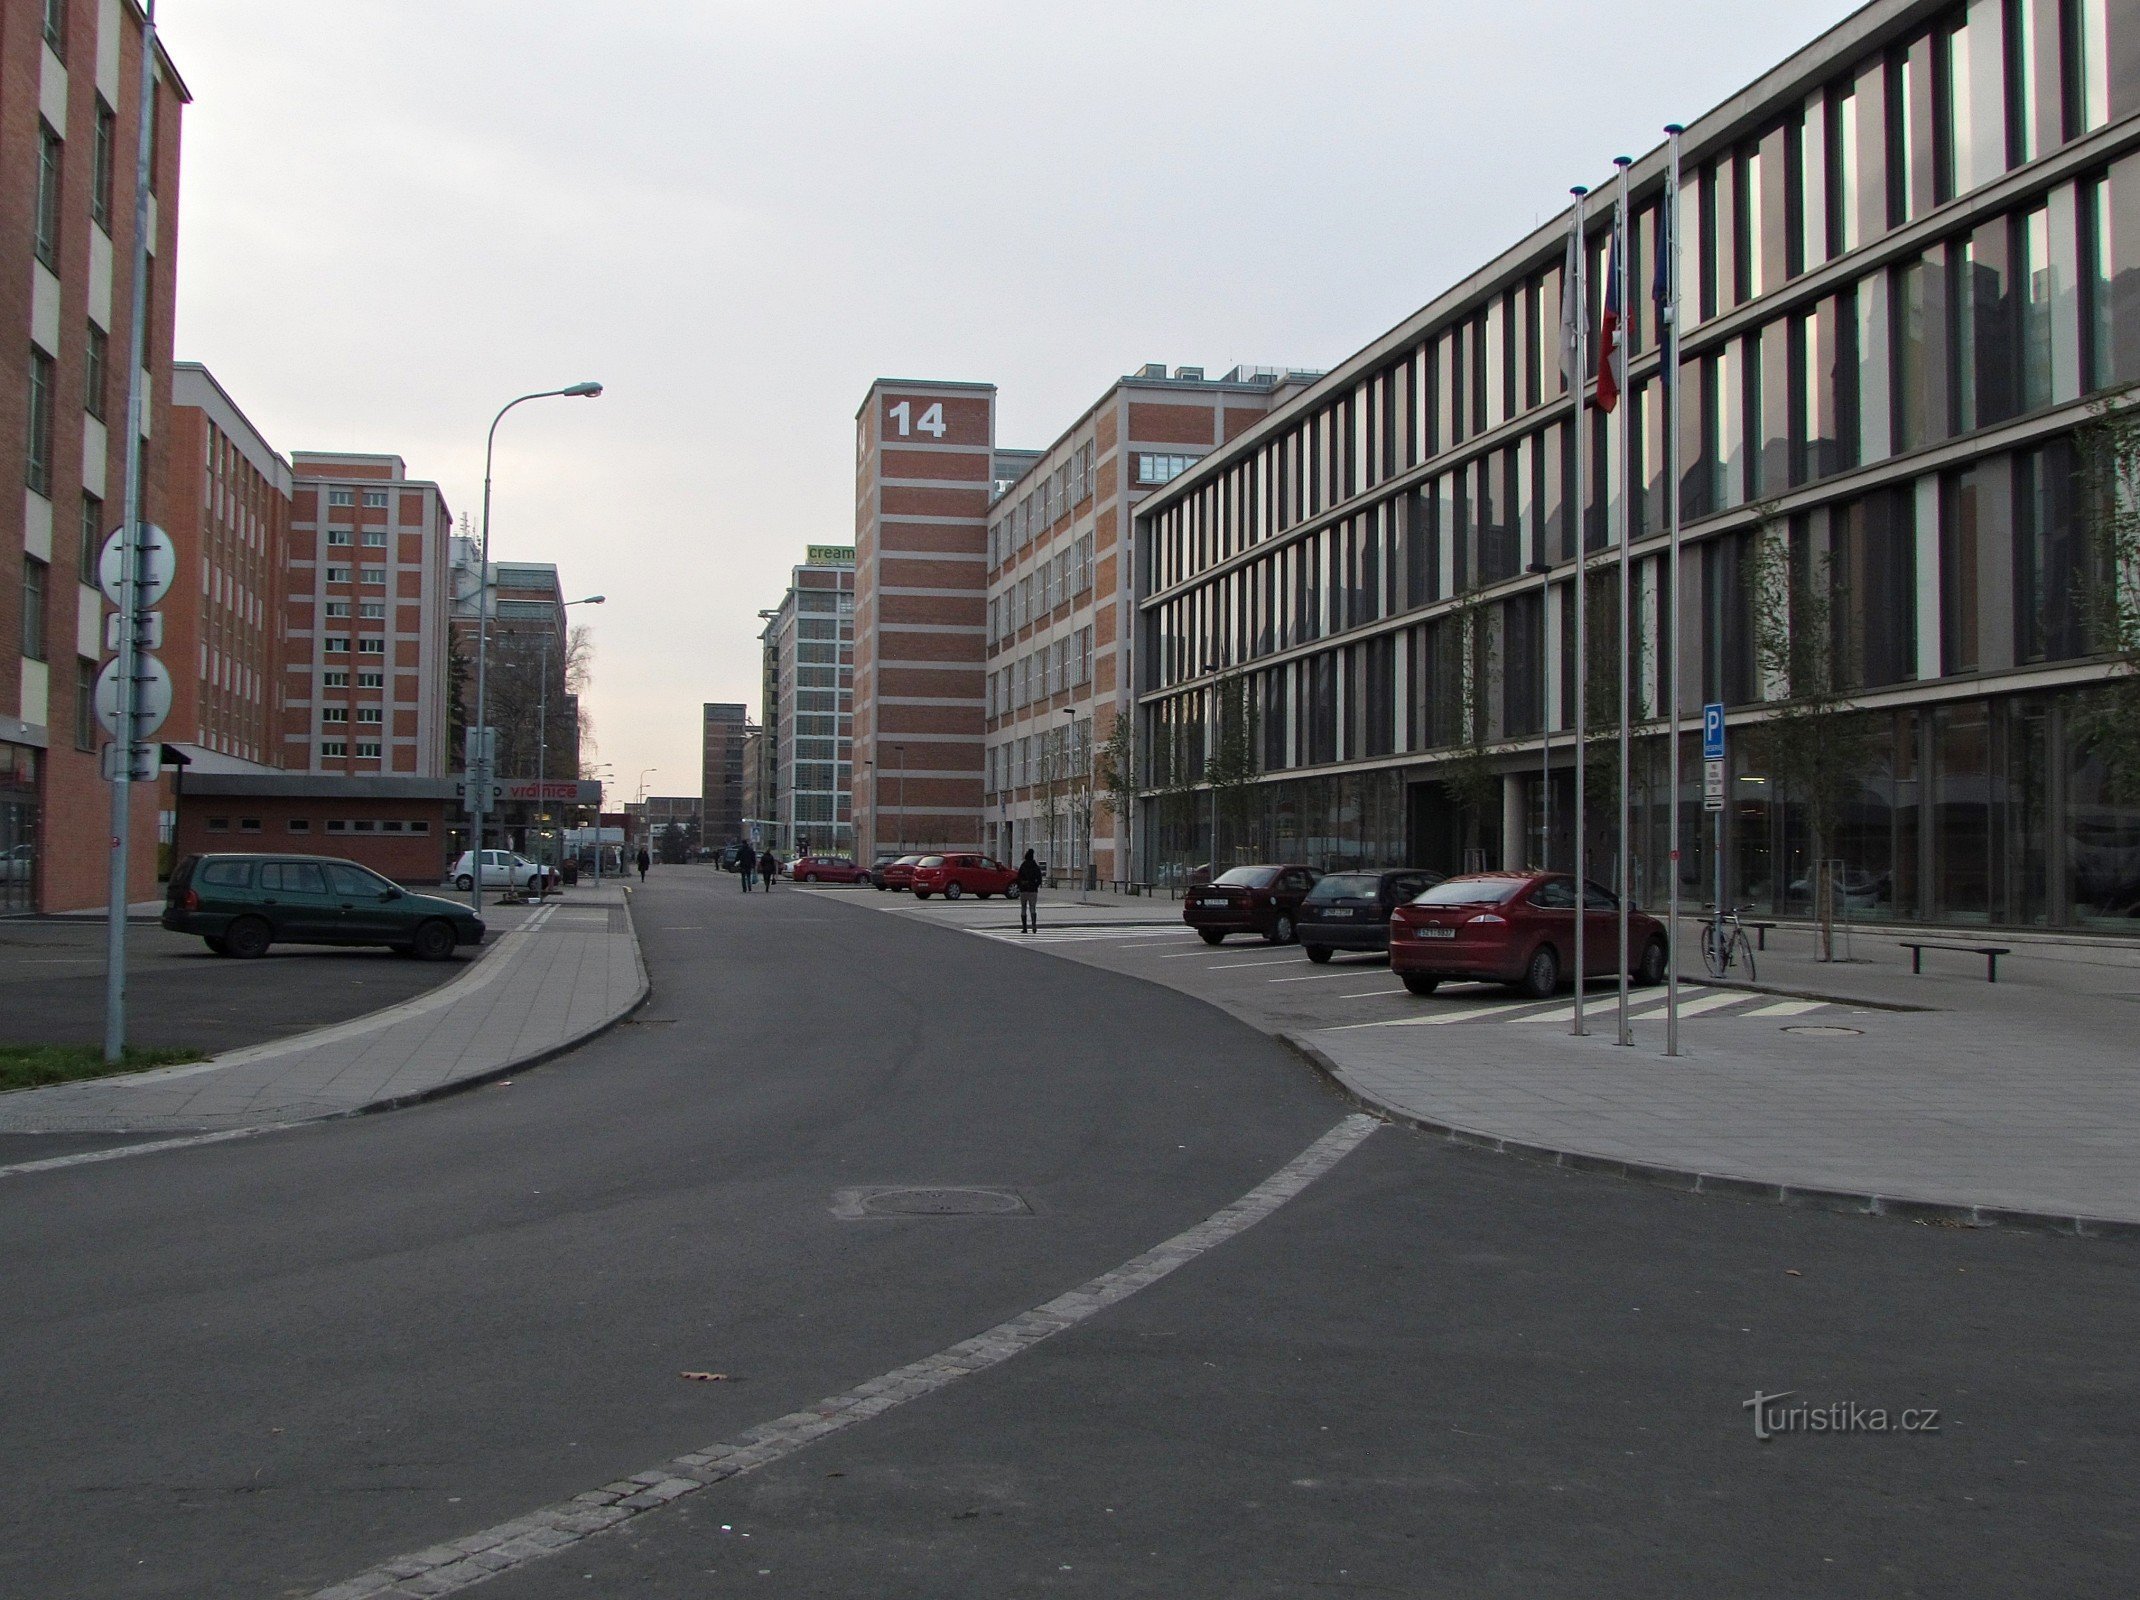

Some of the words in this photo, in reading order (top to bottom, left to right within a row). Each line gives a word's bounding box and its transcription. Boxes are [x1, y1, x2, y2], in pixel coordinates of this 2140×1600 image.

[889, 401, 947, 438] 14
[809, 548, 856, 559] cream
[1708, 711, 1719, 741] P
